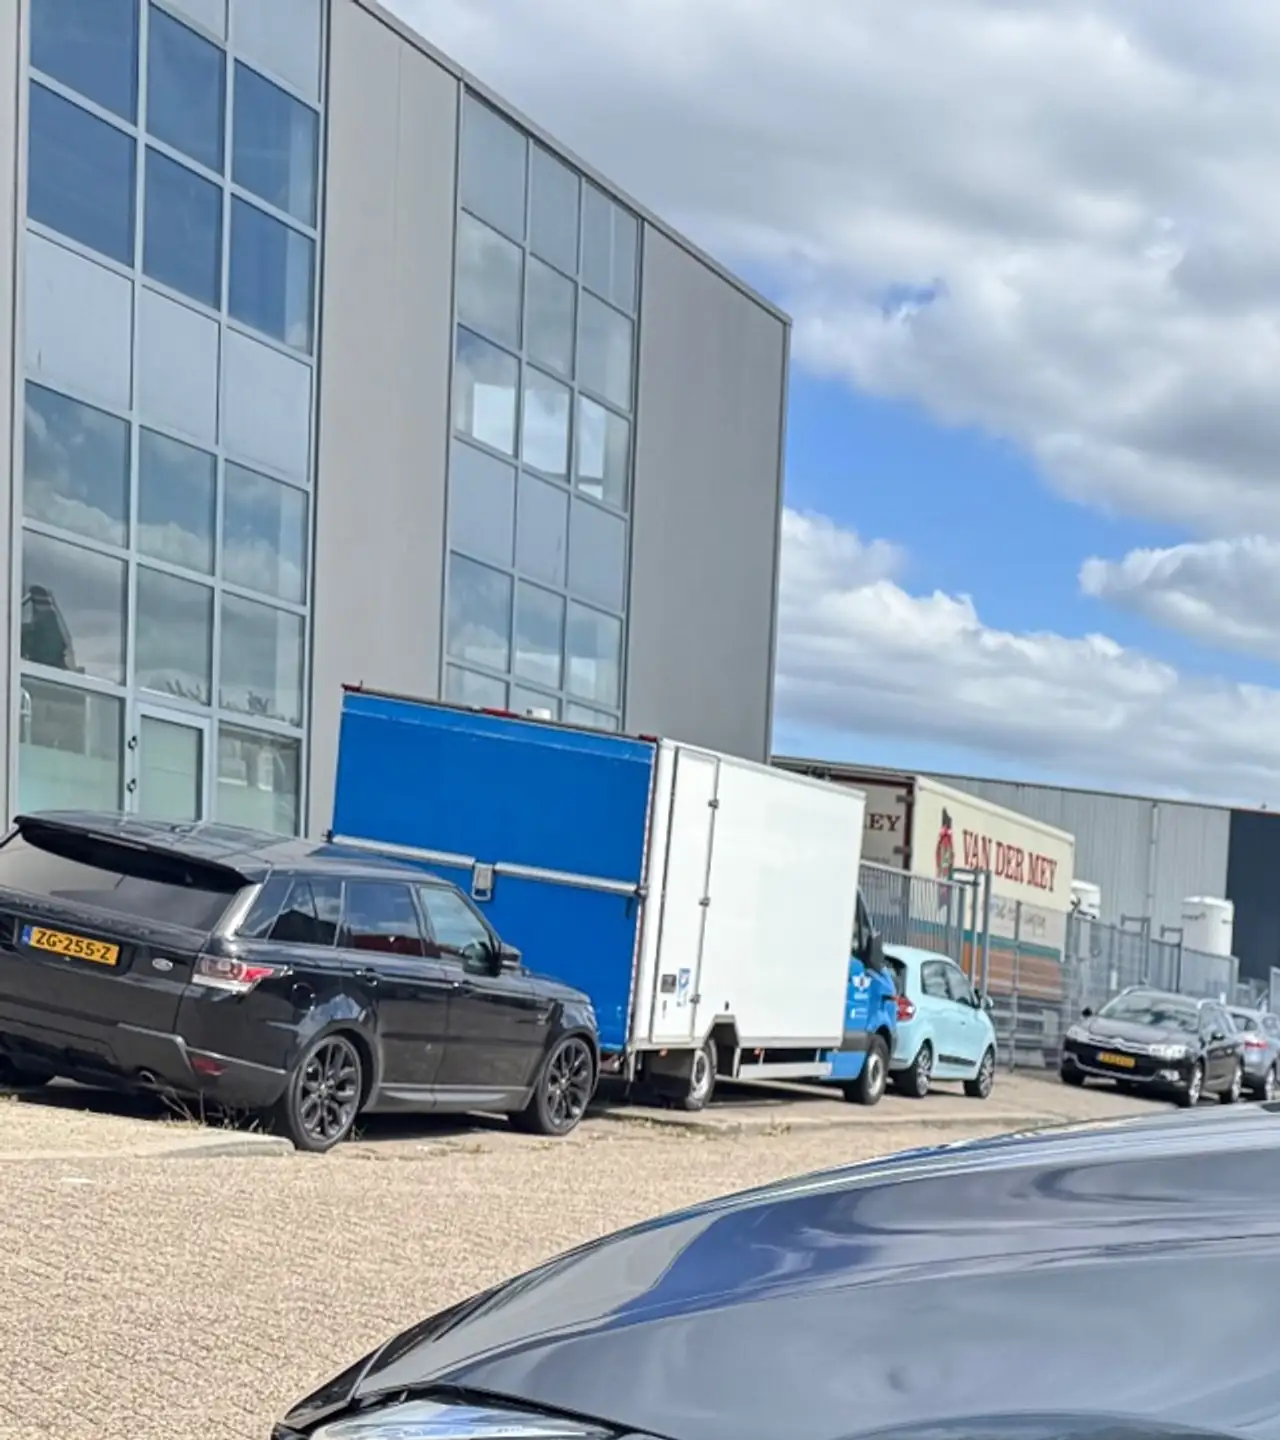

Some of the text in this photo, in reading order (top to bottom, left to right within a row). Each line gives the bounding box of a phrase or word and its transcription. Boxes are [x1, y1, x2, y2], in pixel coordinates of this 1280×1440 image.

[864, 812, 902, 832] EY
[962, 829, 1058, 893] VAN DER MEY
